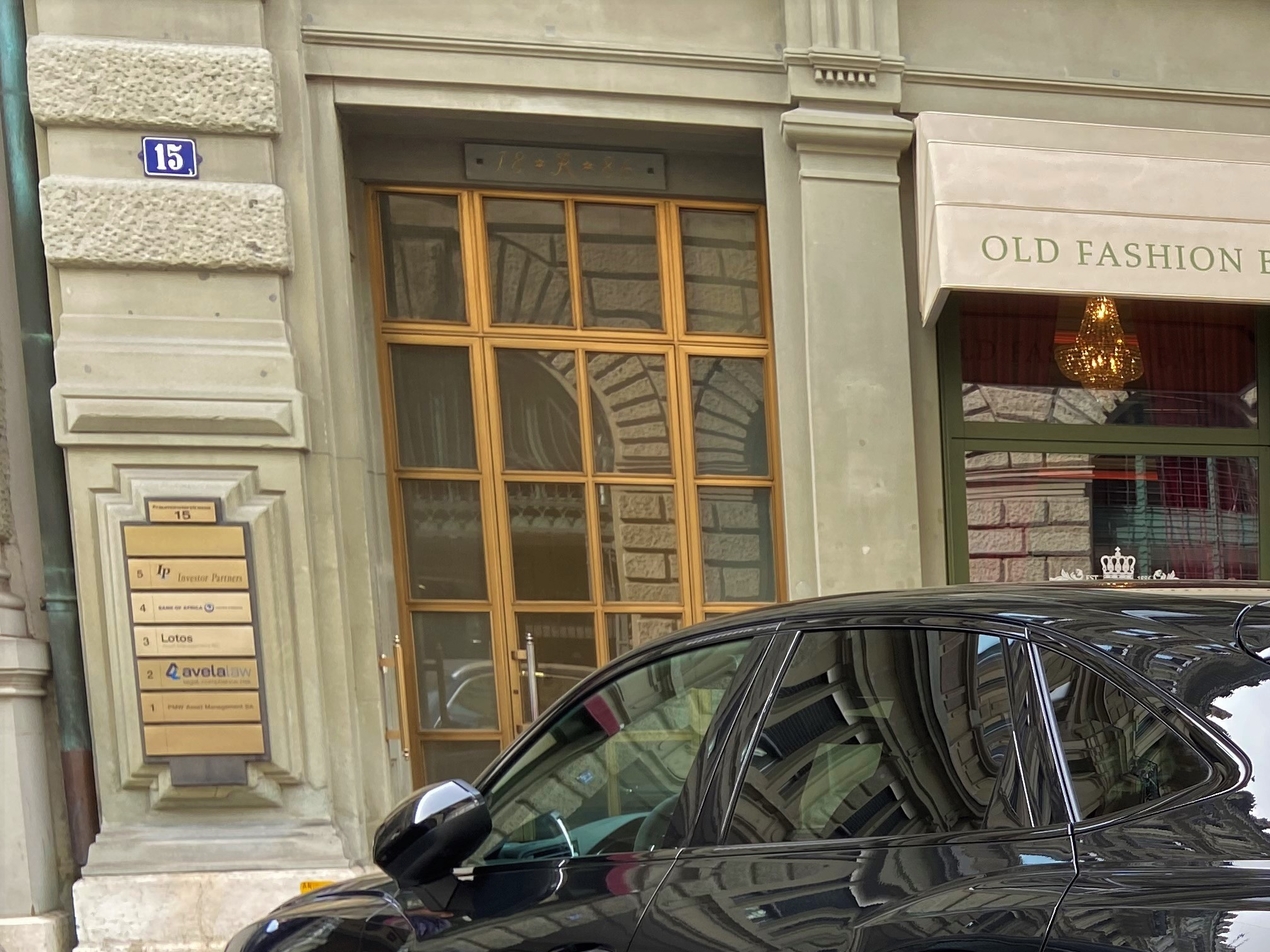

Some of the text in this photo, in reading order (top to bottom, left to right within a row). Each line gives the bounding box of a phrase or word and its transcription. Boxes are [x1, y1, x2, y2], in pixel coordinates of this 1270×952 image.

[154, 143, 184, 170] 15
[981, 235, 1060, 264] OLD
[1076, 240, 1243, 273] FASHION
[174, 510, 191, 520] 15
[136, 569, 143, 579] 5
[177, 573, 243, 583] Investor Partners
[139, 603, 146, 613] 4
[142, 636, 150, 646] 3
[161, 634, 193, 643] Lotos
[147, 670, 154, 679] 2
[150, 703, 155, 712] 1
